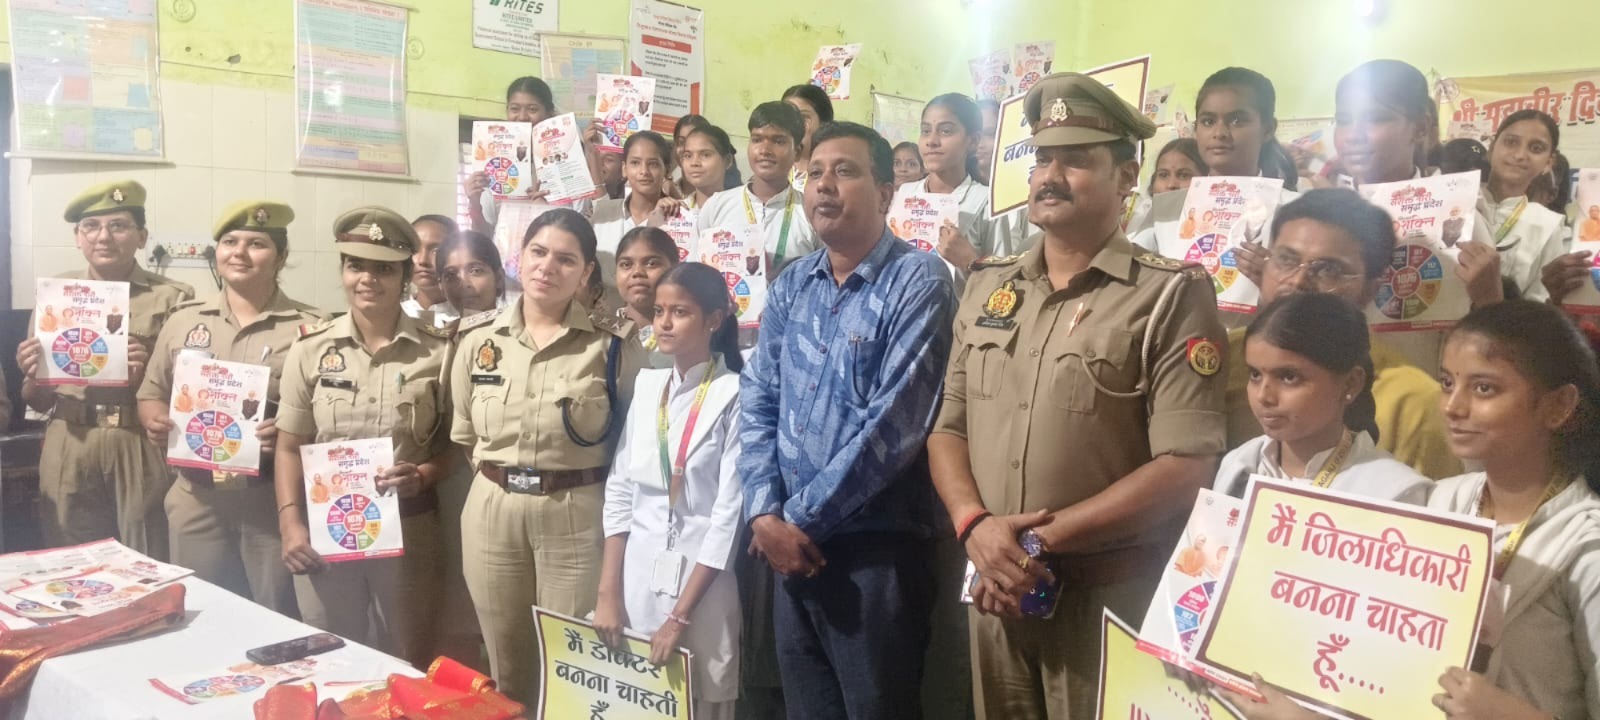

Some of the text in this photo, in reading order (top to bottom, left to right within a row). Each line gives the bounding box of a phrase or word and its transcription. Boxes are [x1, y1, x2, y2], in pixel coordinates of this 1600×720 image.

[504, 0, 544, 14] RITES
[1267, 503, 1297, 546] मैं
[1301, 512, 1472, 593] जिलाधिकारी
[1270, 570, 1449, 651] बनना चाहता
[563, 627, 584, 654] मैं
[554, 660, 678, 717] बनना चाहती
[590, 700, 610, 720] हँ
